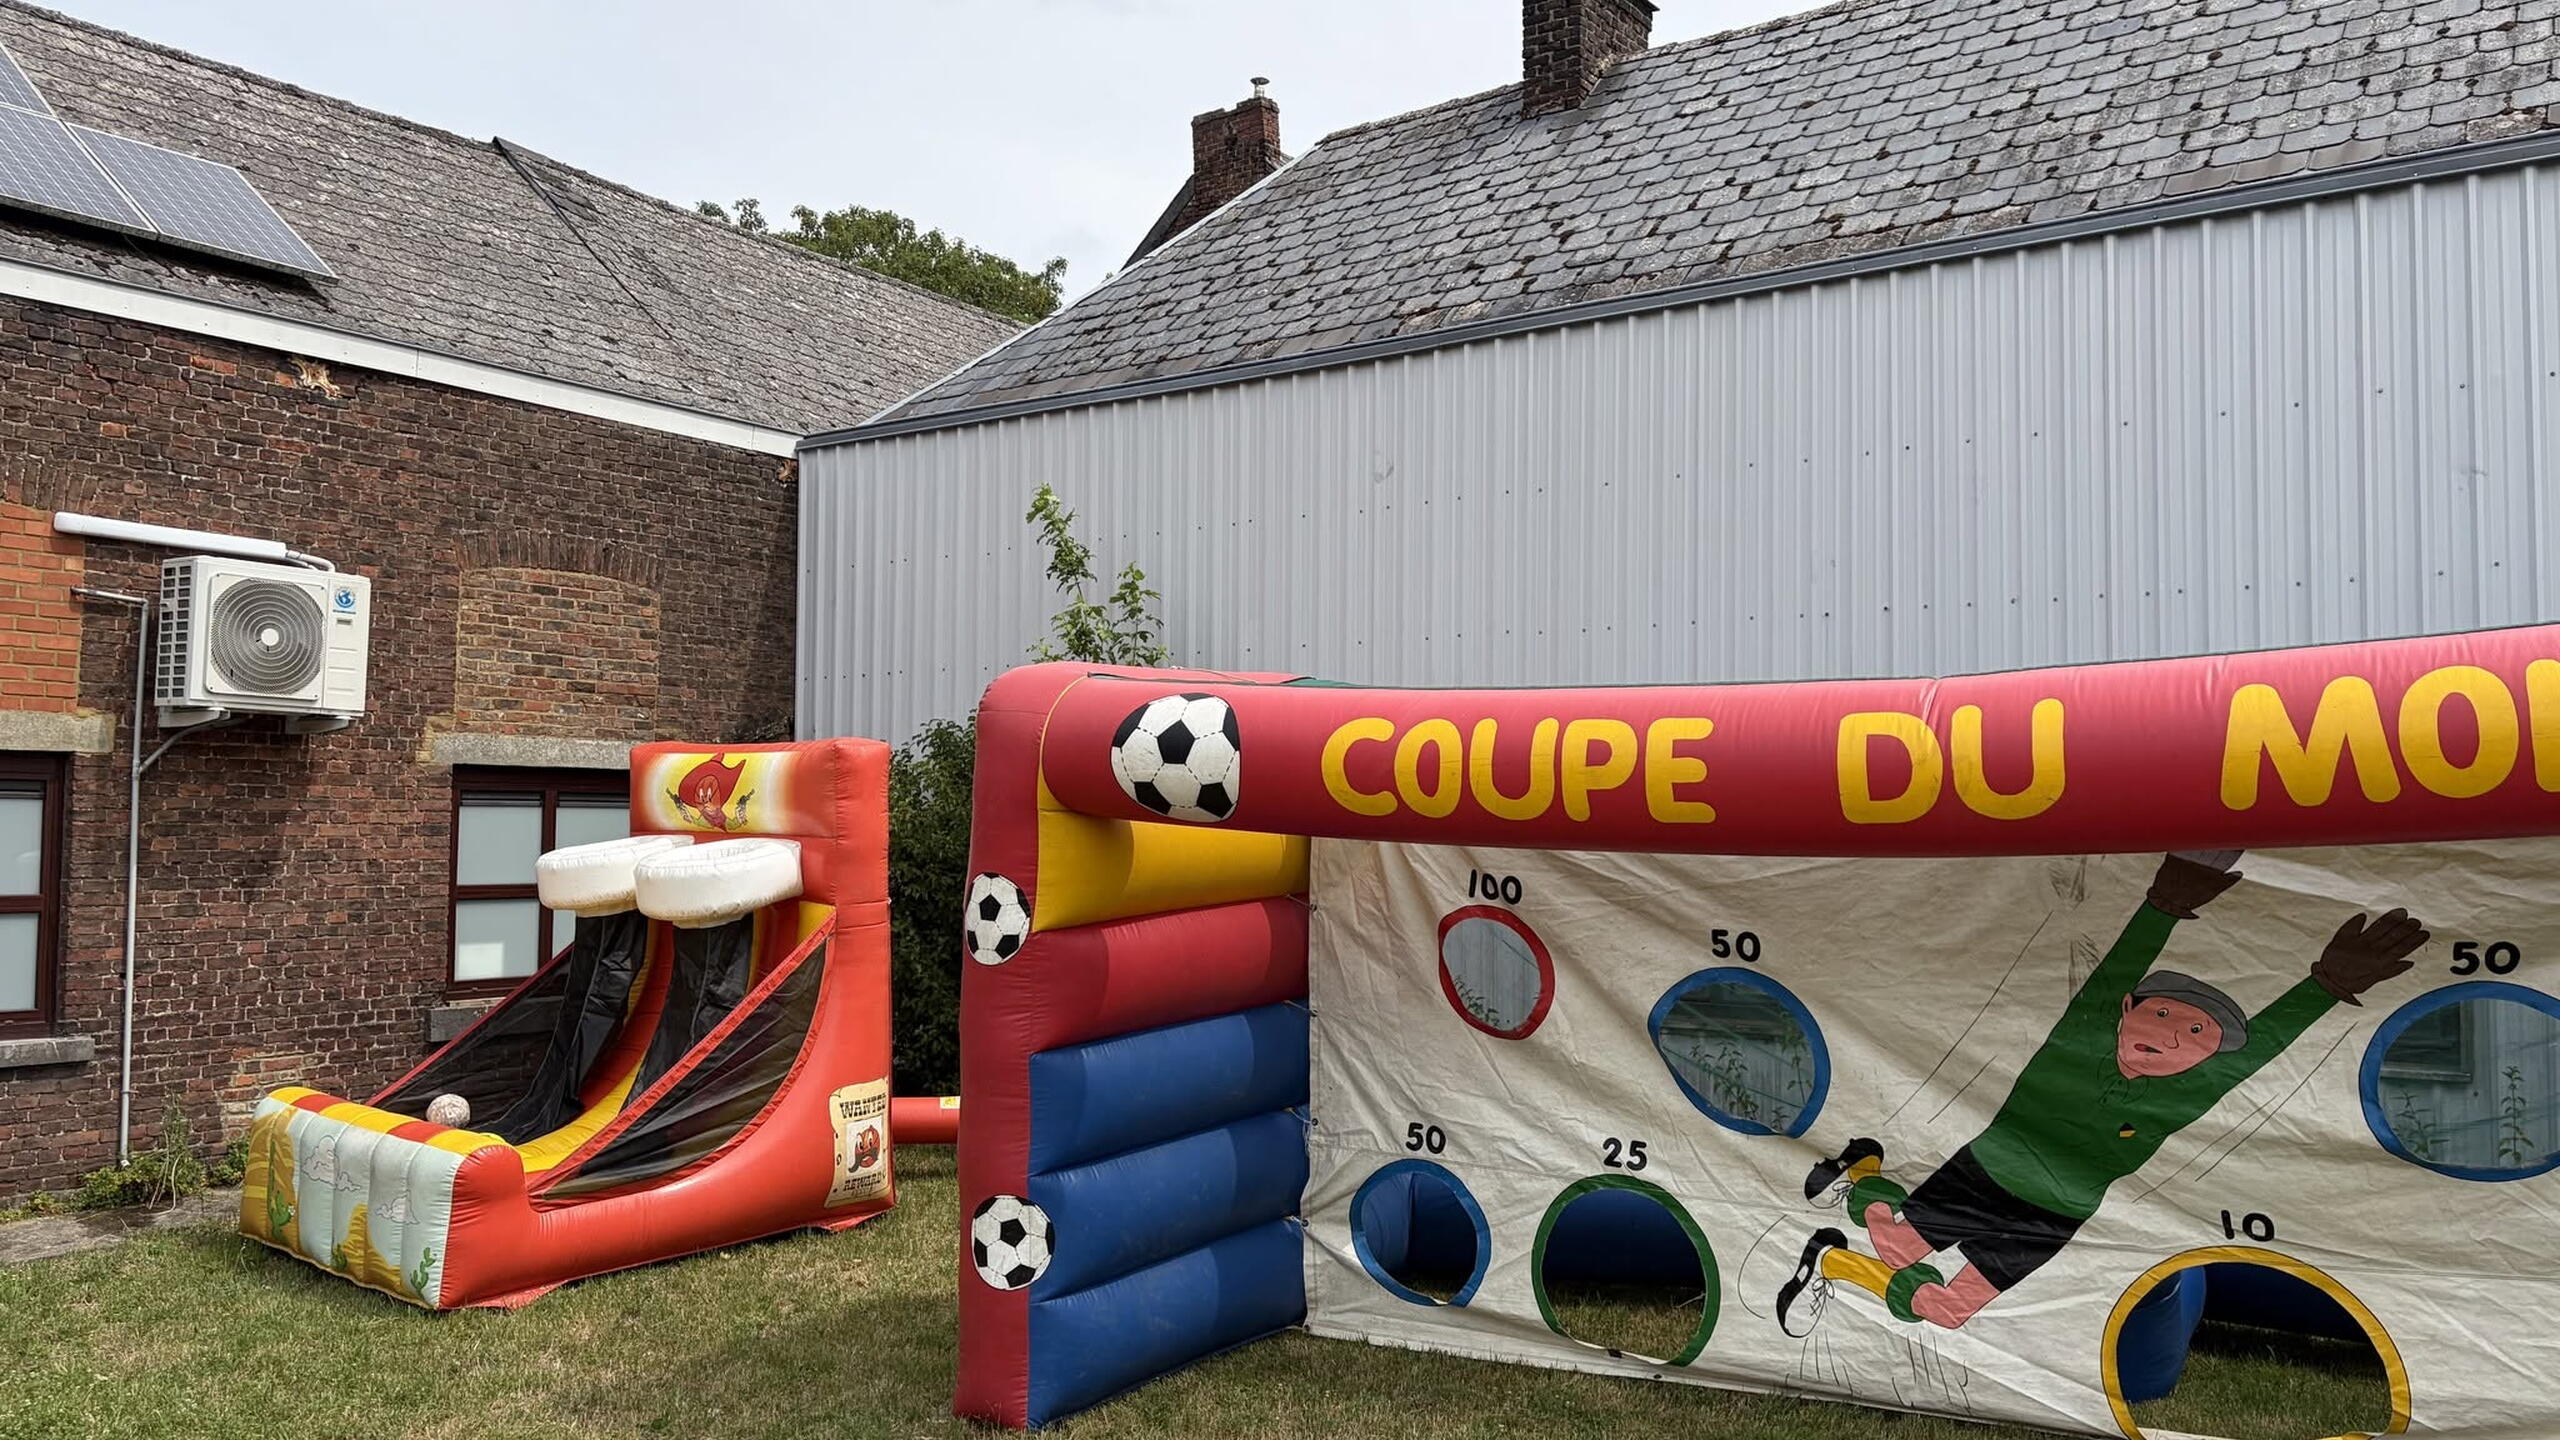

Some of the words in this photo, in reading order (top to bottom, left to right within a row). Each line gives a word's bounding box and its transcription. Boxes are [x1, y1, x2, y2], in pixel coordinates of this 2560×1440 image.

[1321, 717, 1716, 823] COUPE
[1836, 698, 2066, 824] DU
[1468, 868, 1523, 905] 100
[1711, 929, 1761, 962] 50
[2449, 941, 2521, 975] 50
[839, 1092, 887, 1119] WANTED
[1405, 1122, 1446, 1154] 50
[1602, 1137, 1647, 1171] 25
[843, 1171, 882, 1191] REWARD
[2221, 1209, 2274, 1242] 10
